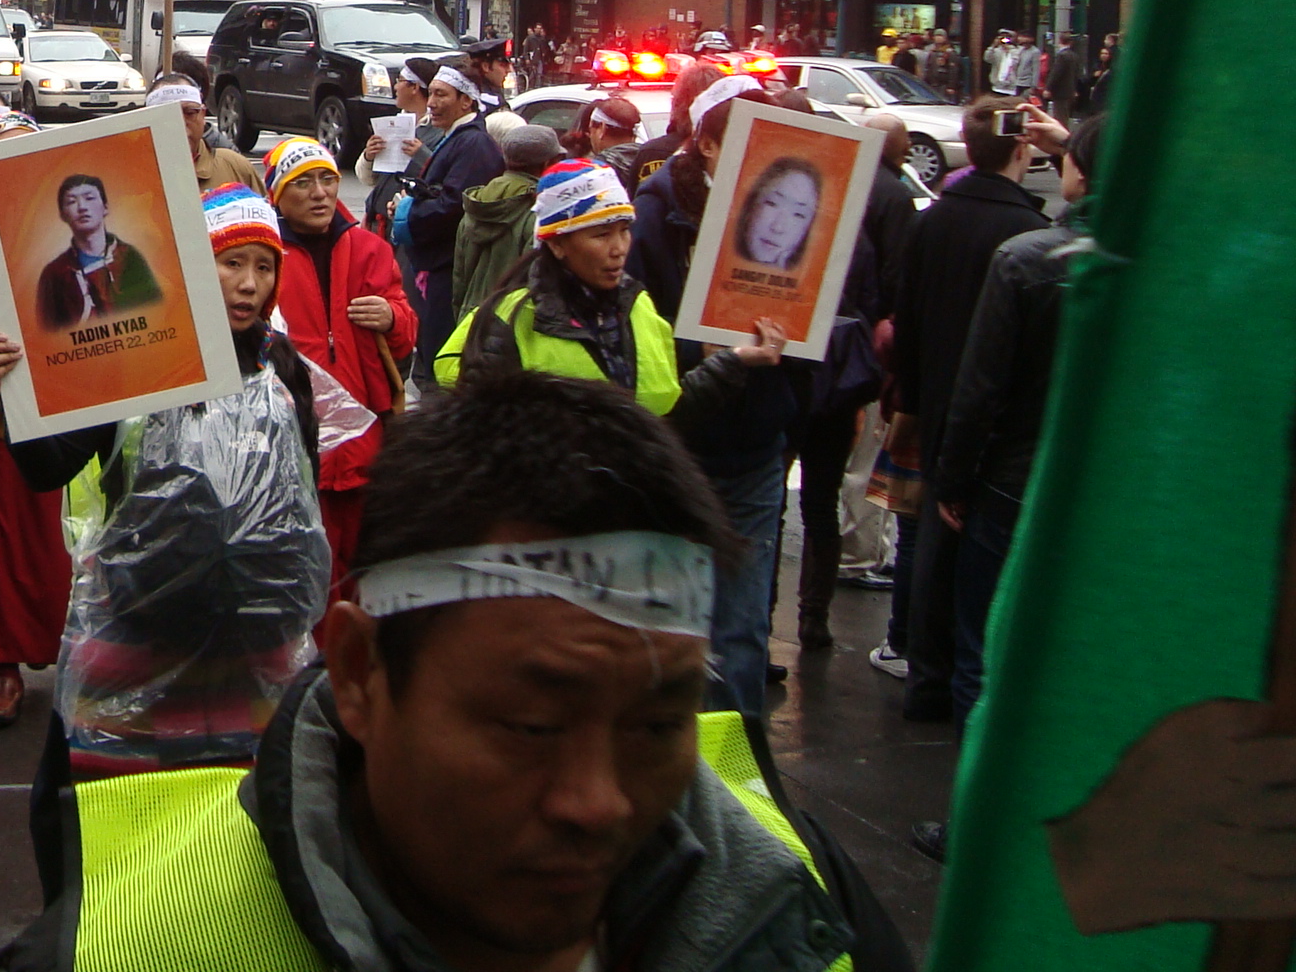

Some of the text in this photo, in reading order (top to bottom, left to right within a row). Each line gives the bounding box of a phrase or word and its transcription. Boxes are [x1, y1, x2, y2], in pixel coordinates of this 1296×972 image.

[556, 178, 594, 203] SAVE
[207, 211, 226, 227] VE
[70, 316, 148, 346] TADIN KYAB
[46, 327, 177, 366] NOVEMBER 22, 2012
